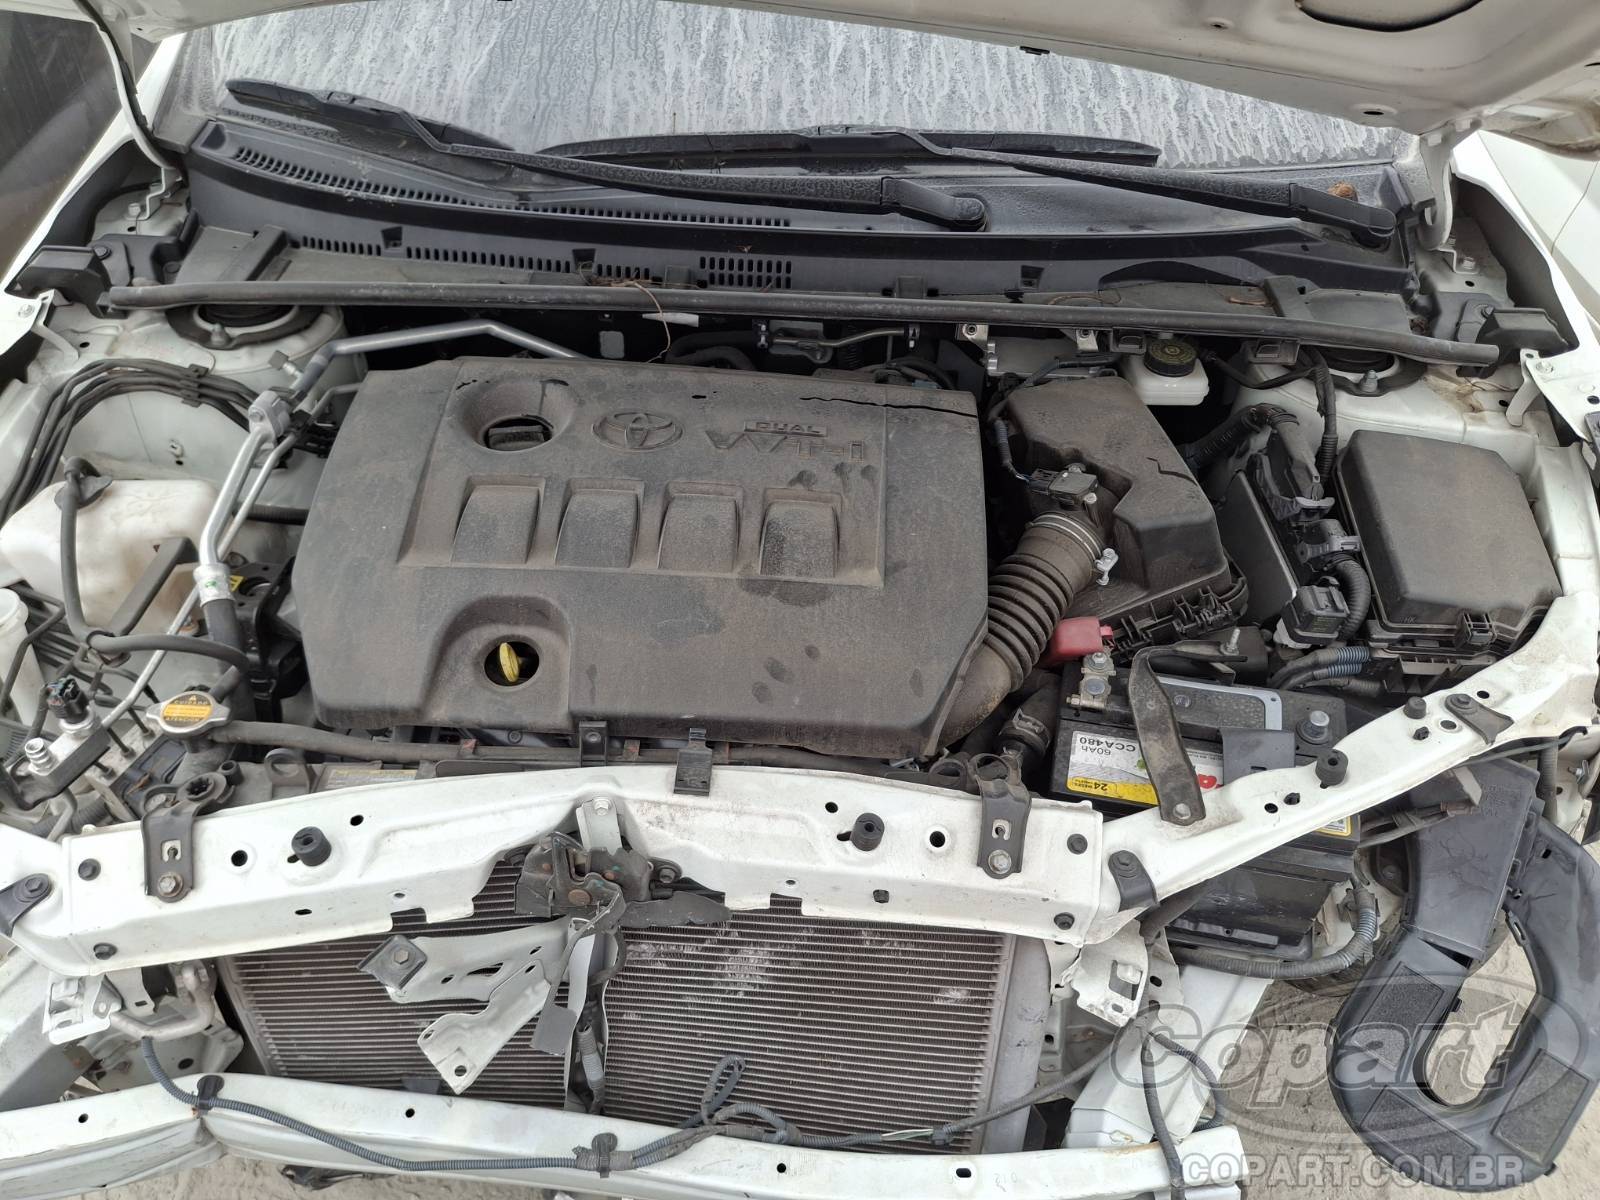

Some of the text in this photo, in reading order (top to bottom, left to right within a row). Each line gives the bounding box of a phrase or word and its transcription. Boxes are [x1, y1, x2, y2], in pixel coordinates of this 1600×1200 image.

[755, 421, 821, 433] DUAL
[1079, 736, 1136, 753] CCA480
[1081, 744, 1112, 757] 60Ah
[1094, 781, 1109, 792] 24
